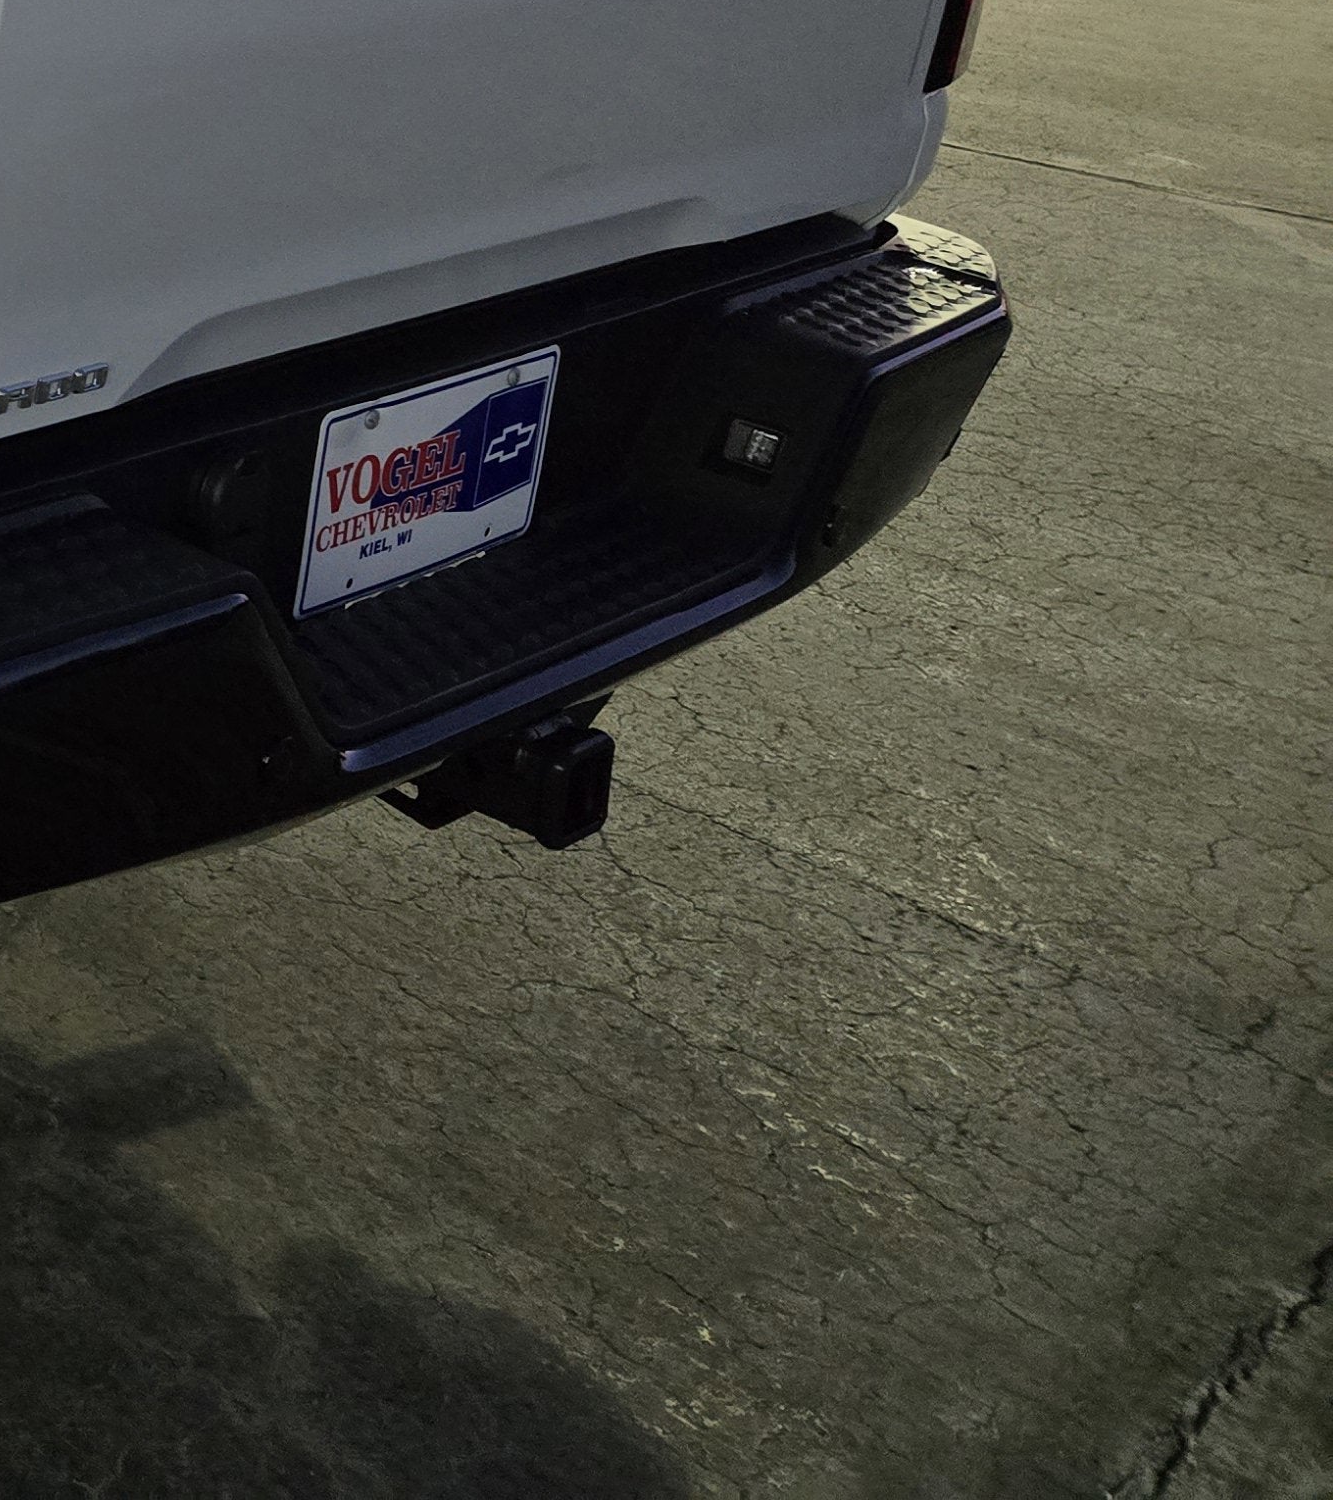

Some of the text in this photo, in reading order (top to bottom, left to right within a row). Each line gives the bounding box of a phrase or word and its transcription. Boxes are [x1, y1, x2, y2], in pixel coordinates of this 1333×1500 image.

[325, 429, 467, 515] VOGEL
[315, 479, 464, 553] CHEVROLET
[358, 528, 413, 560] KIEL, WI
